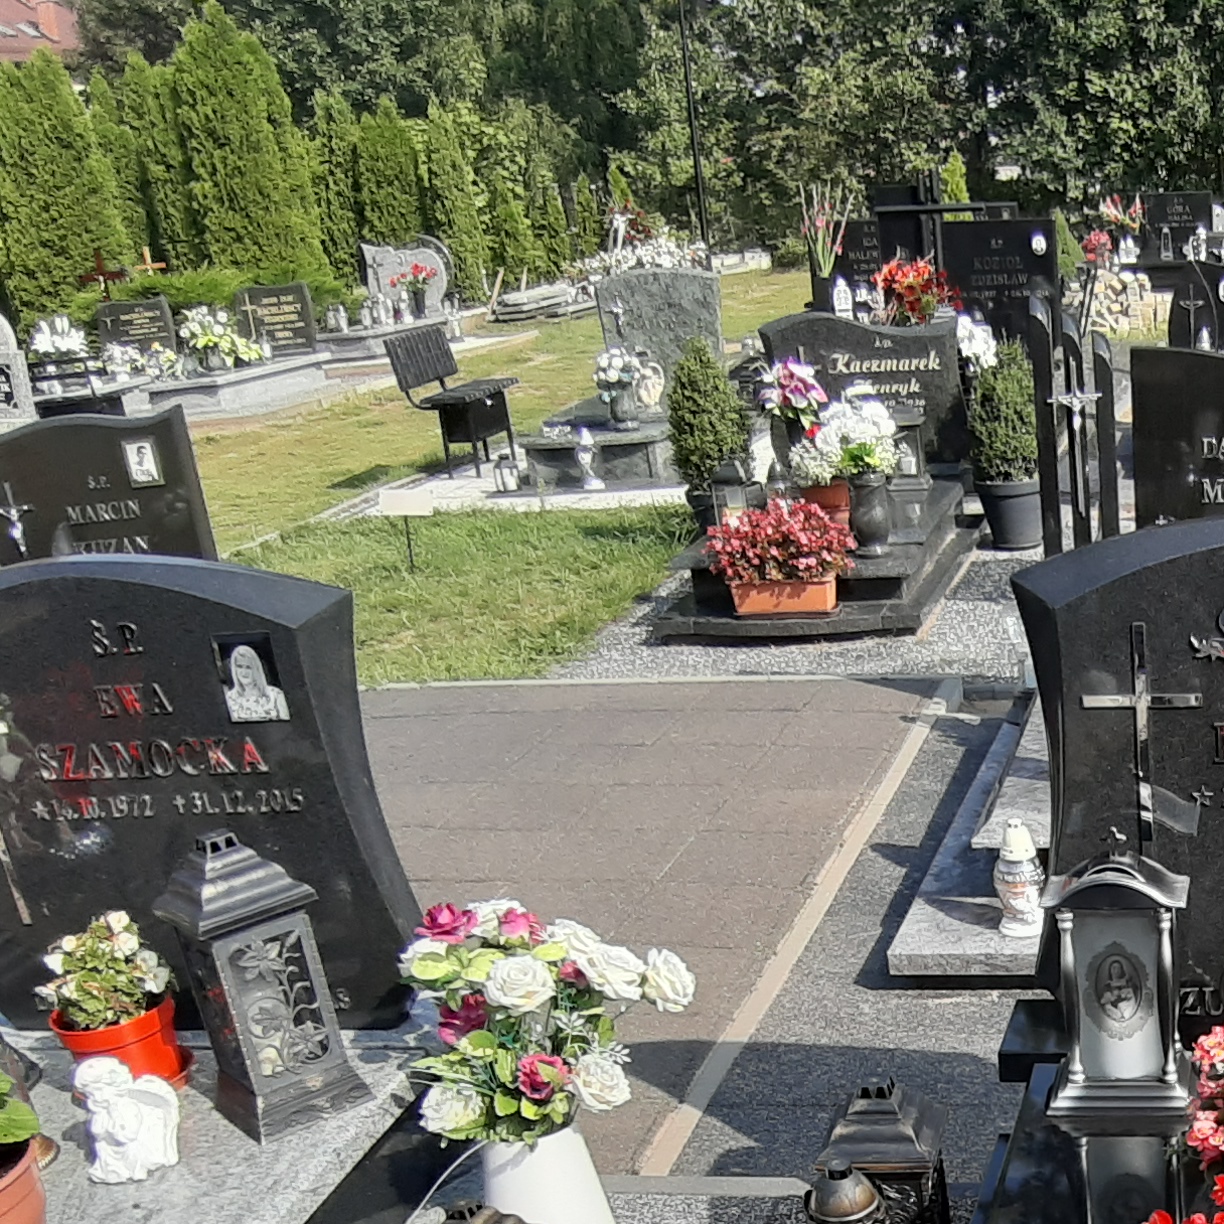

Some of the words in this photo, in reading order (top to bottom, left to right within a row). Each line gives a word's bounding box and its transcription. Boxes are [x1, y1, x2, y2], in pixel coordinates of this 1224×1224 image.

[828, 349, 942, 375] Kaczmarek
[66, 499, 142, 526] MARCIN
[93, 683, 174, 718] EWA
[35, 736, 271, 782] SZAMOCKA
